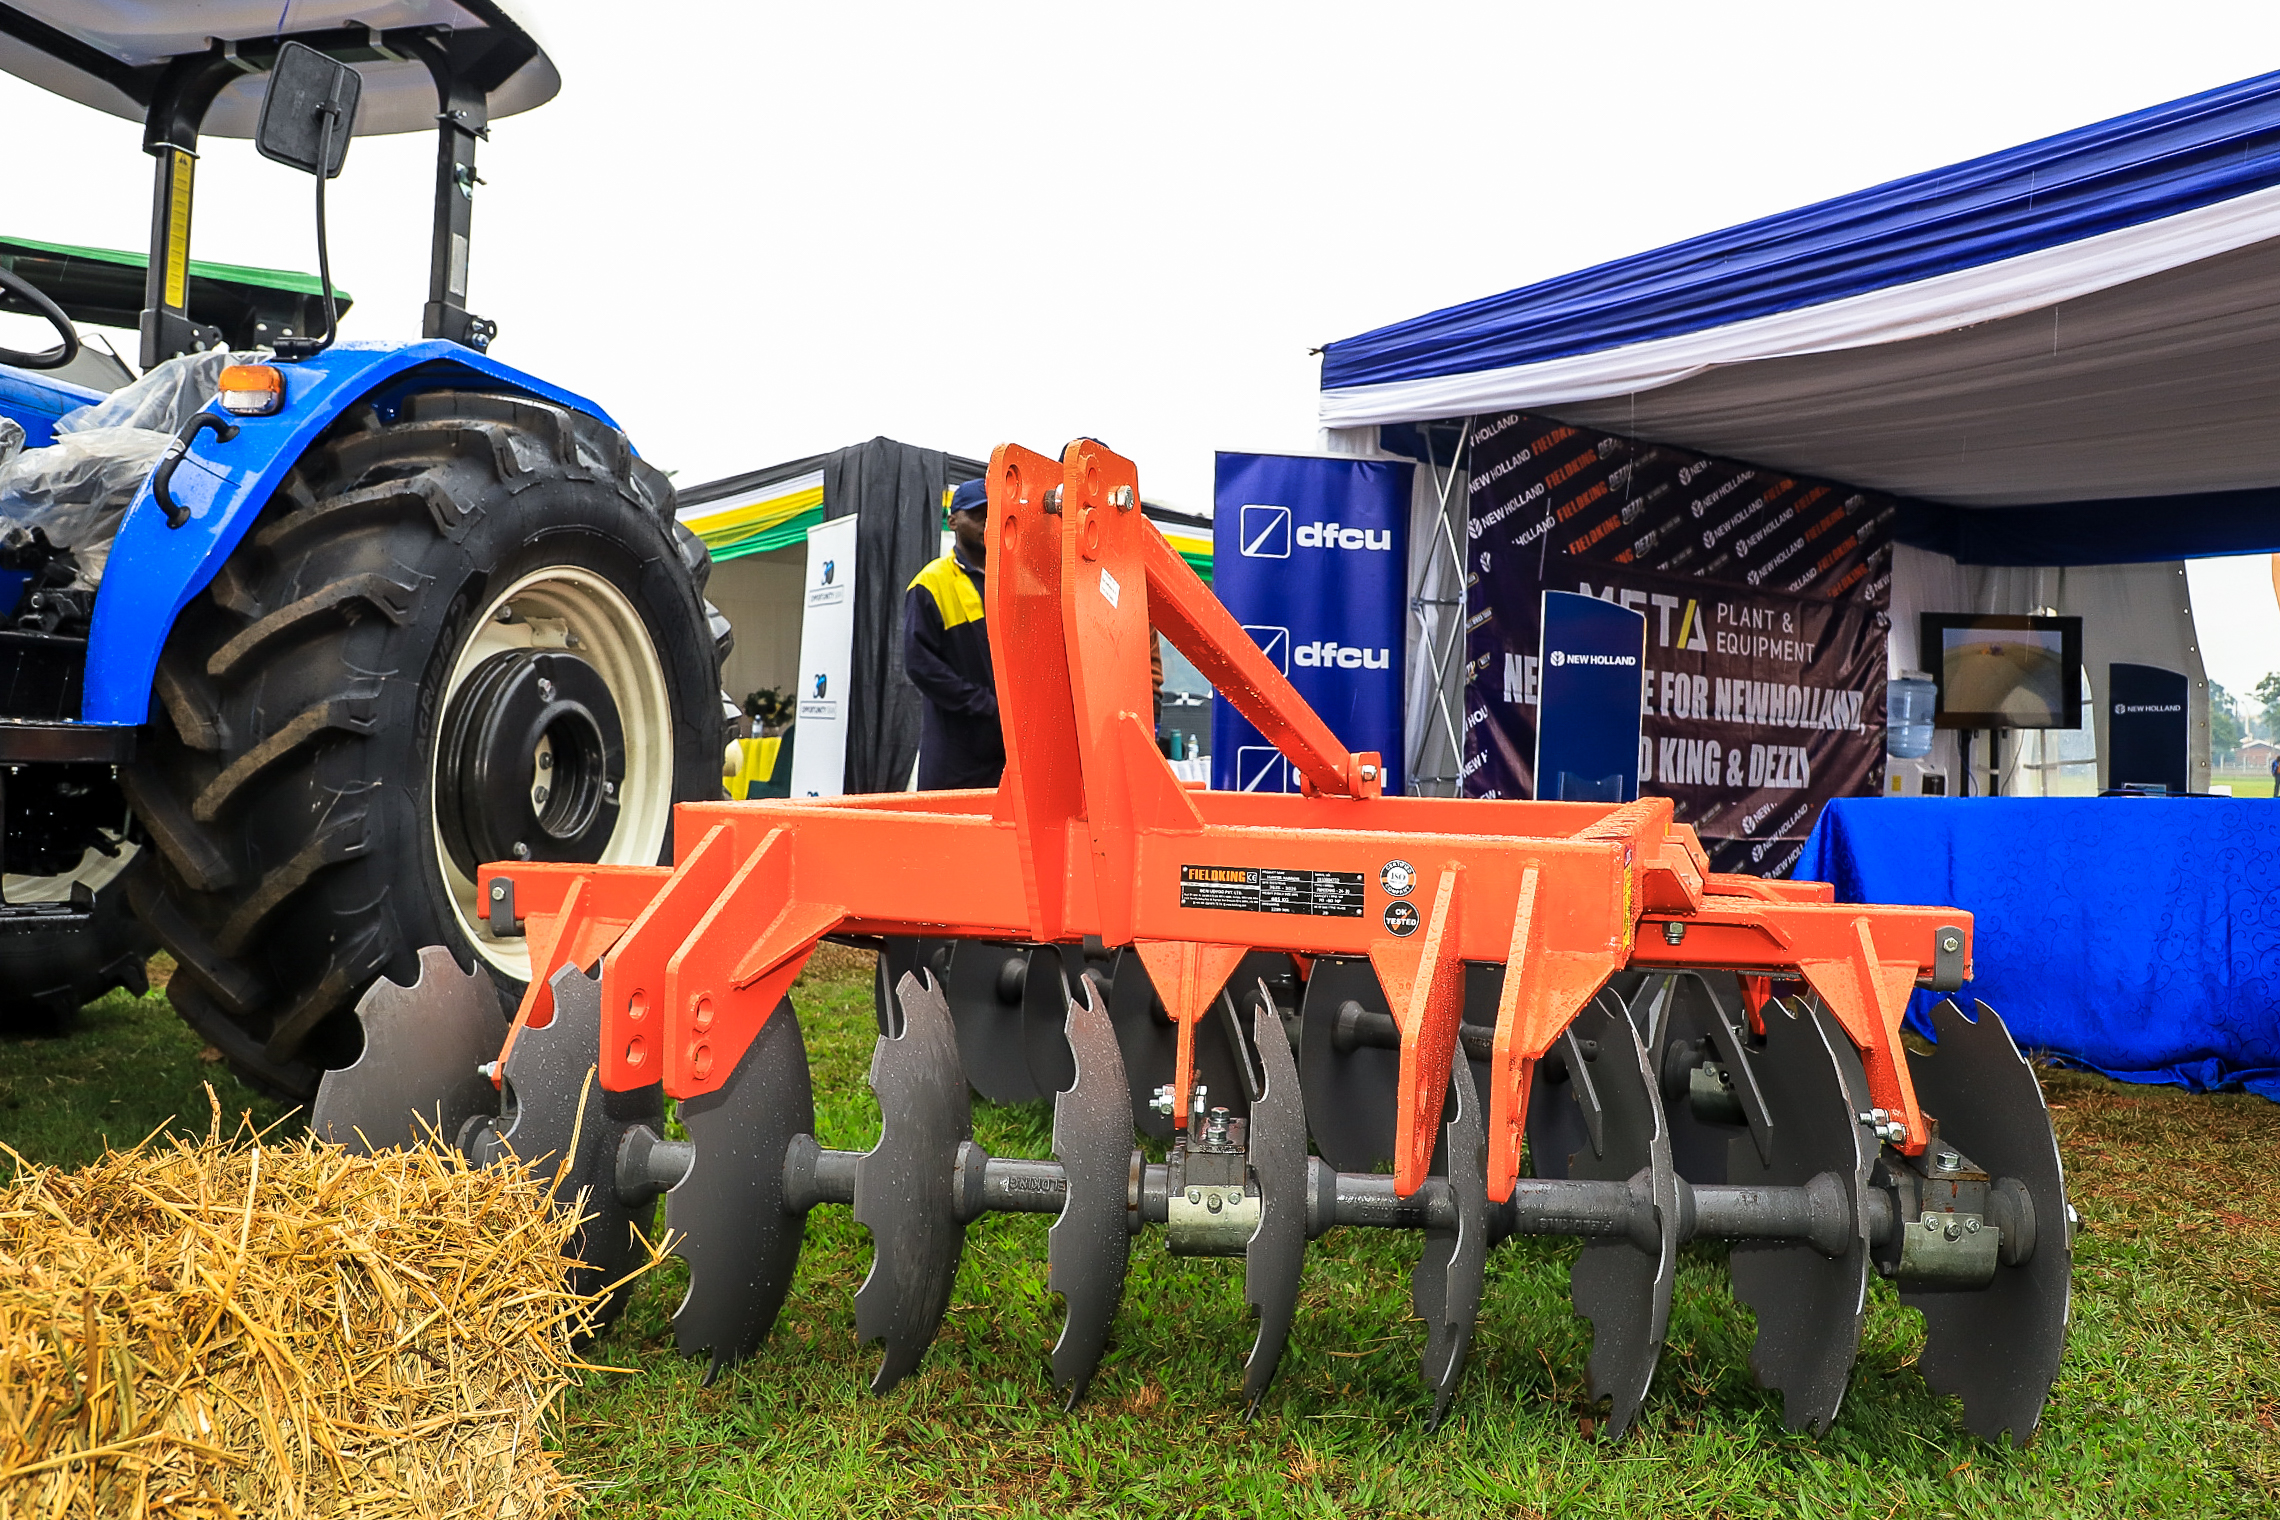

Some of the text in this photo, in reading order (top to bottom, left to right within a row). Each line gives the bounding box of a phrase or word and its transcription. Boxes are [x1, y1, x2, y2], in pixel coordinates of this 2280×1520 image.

[1475, 414, 1519, 443] HOLLAND
[1469, 472, 1490, 494] NEW
[1491, 449, 1531, 479] HOLLAND
[1690, 459, 1707, 476] NEW
[1482, 507, 1504, 529] NEW
[1504, 483, 1545, 516] HOLLAND
[1545, 448, 1597, 490] FIELDKING
[1556, 481, 1608, 522] FIELDKING
[1702, 490, 1719, 508] NEW
[1714, 520, 1732, 539] NEW
[1731, 498, 1764, 526] HOLLAND
[1747, 529, 1764, 547] NEW
[1763, 508, 1794, 535] HOLLAND
[1296, 521, 1391, 550] dfcu
[1569, 515, 1621, 555] FIELDKING
[1758, 560, 1775, 578] NEW
[1774, 537, 1805, 563] HOLLAND
[1717, 602, 1793, 634] PLANT &
[1294, 641, 1389, 669] dfcu
[1566, 654, 1636, 666] NEW HOLLAND
[1716, 631, 1814, 664] EQUIPMENT
[1661, 671, 1708, 720] FOR
[2145, 704, 2181, 712] HOLLAND
[1463, 755, 1482, 778] NEW
[1659, 737, 1721, 786] KING
[1726, 749, 1744, 786] &
[1754, 803, 1769, 823] NEW
[1762, 833, 1778, 851] NEW
[1778, 803, 1808, 836] HOLLAND
[1188, 868, 1246, 883] FIELDKING
[1390, 872, 1406, 881] ISO
[1772, 861, 1788, 879] NEW
[1385, 883, 1411, 895] COMPANY
[1385, 917, 1417, 926] TESTED
[1395, 908, 1408, 916] OK
